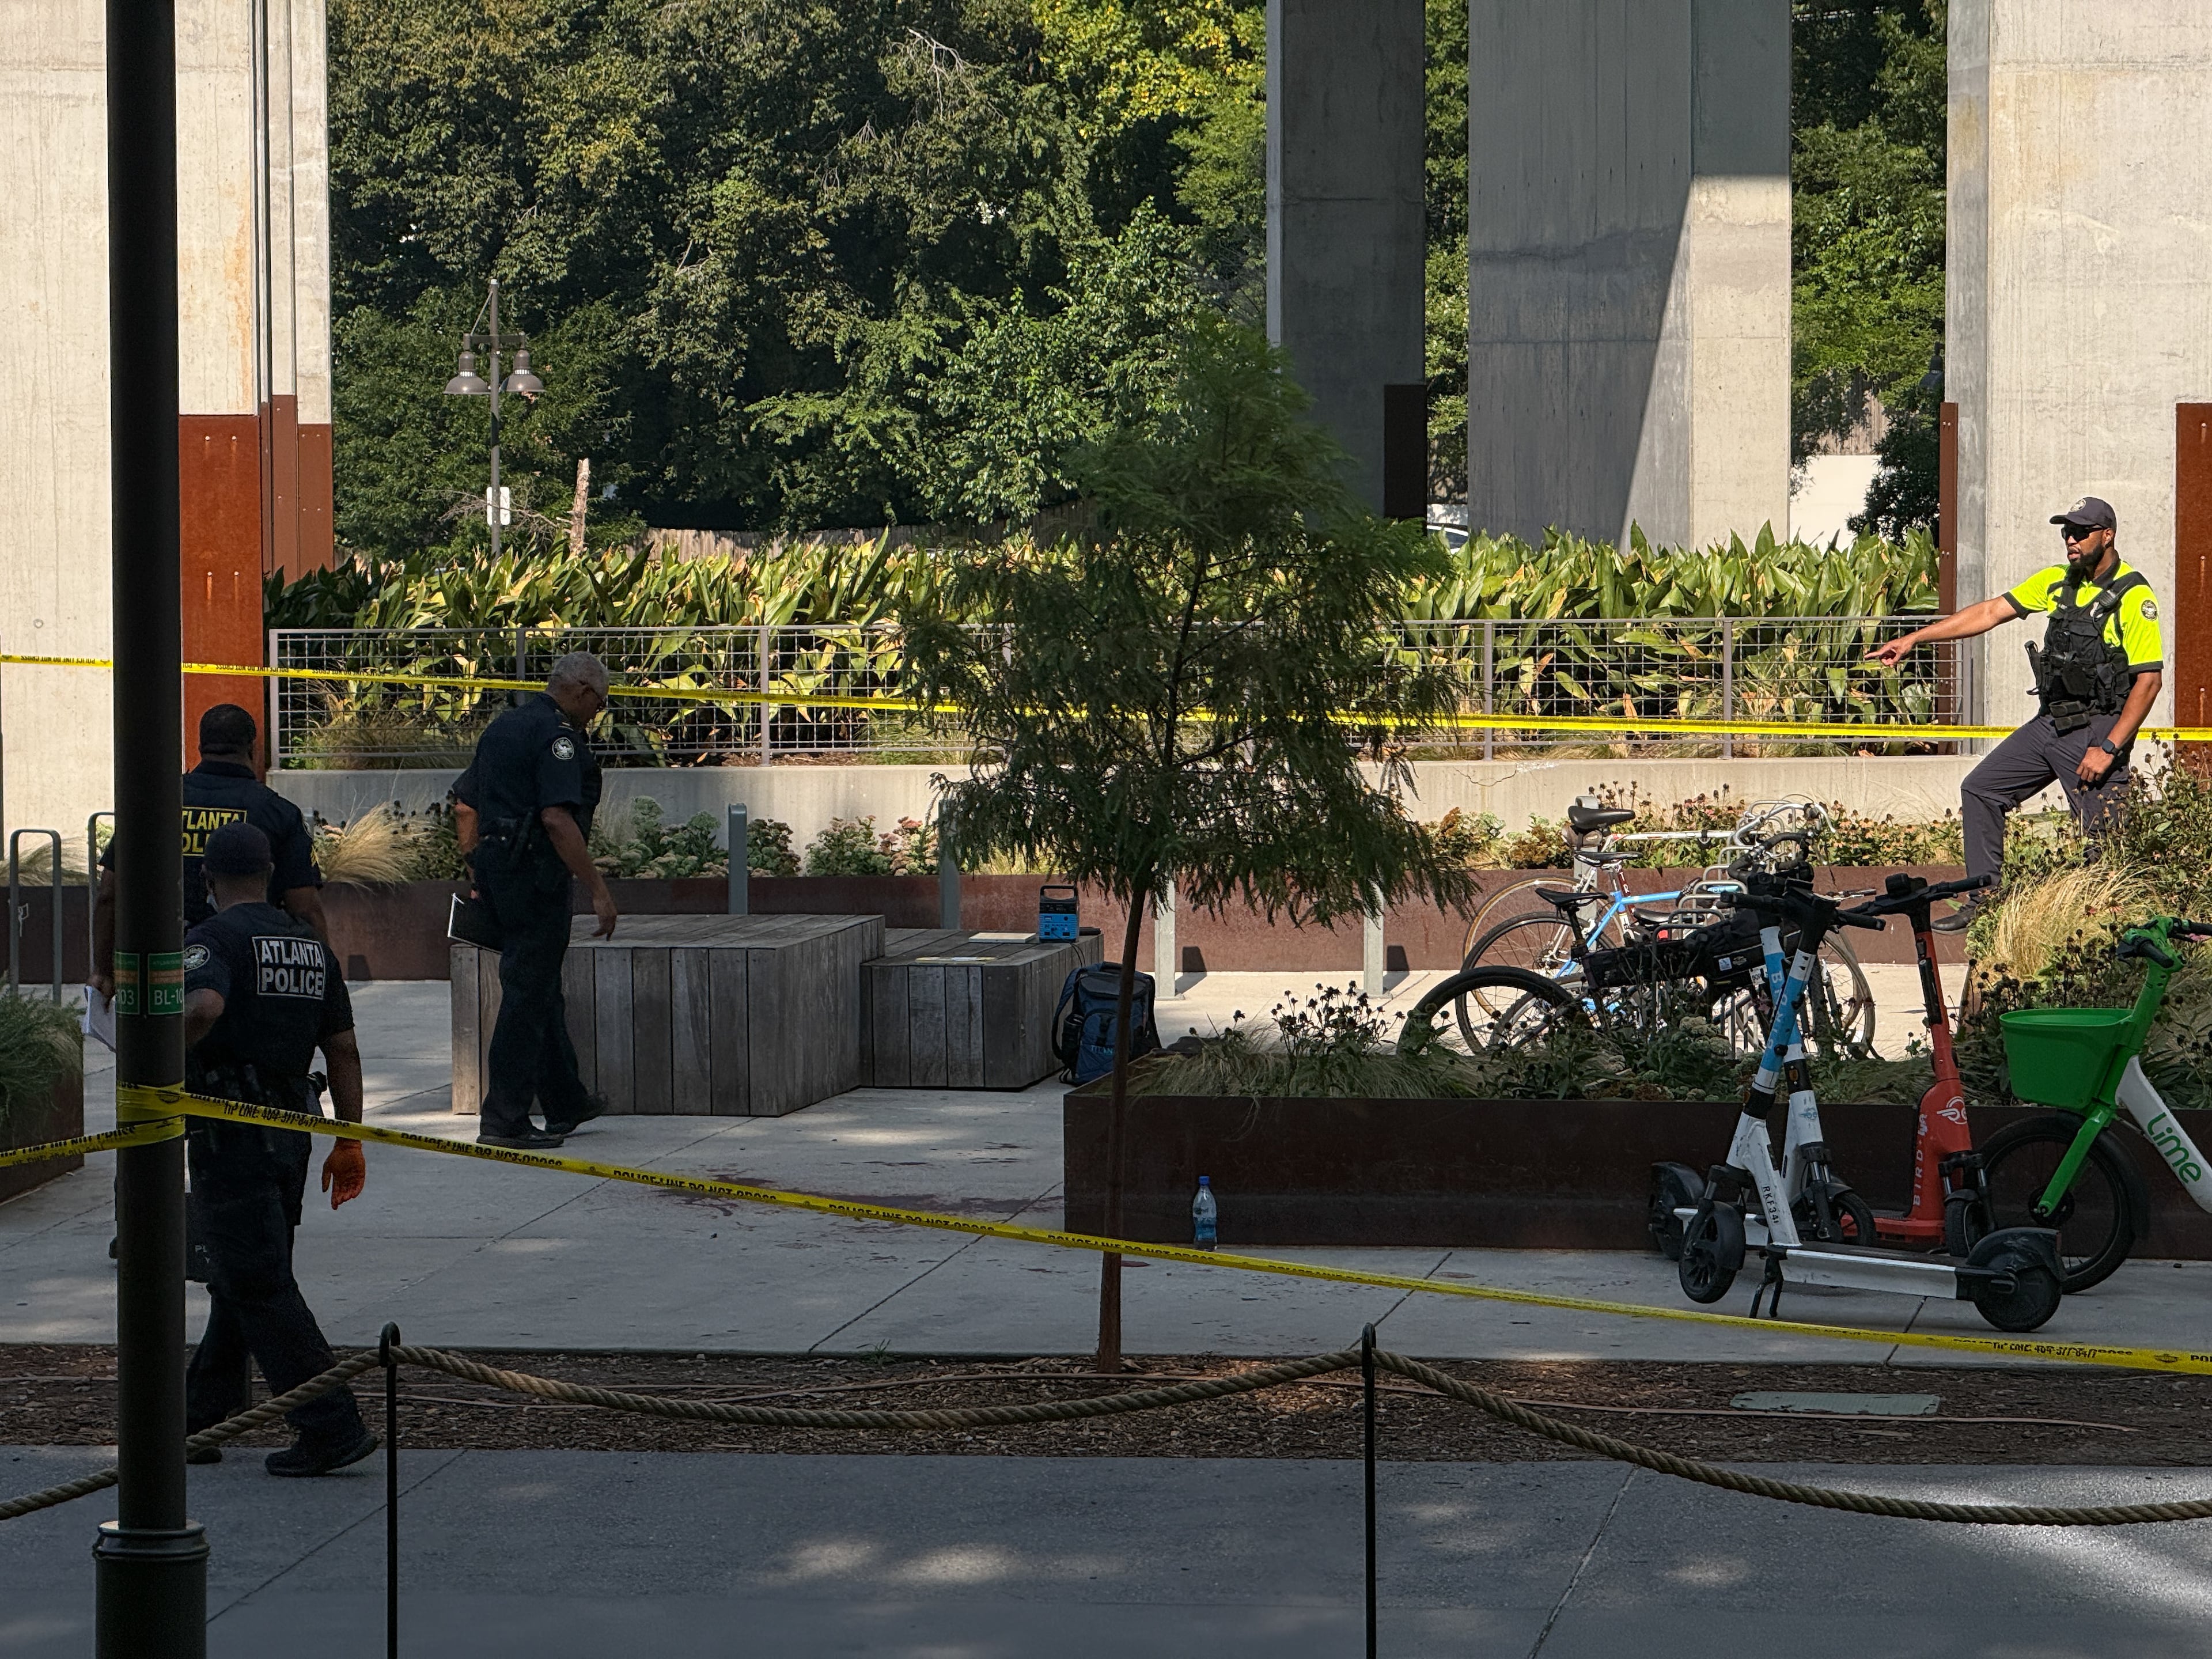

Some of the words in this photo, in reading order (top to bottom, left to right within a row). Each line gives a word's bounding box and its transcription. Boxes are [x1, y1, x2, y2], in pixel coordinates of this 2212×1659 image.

[262, 940, 323, 968] ATLANTA
[262, 967, 323, 996] POLICE
[2147, 1112, 2202, 1184] Lime
[1913, 1150, 1923, 1206] BIRD
[1763, 1185, 1779, 1224] RKF341
